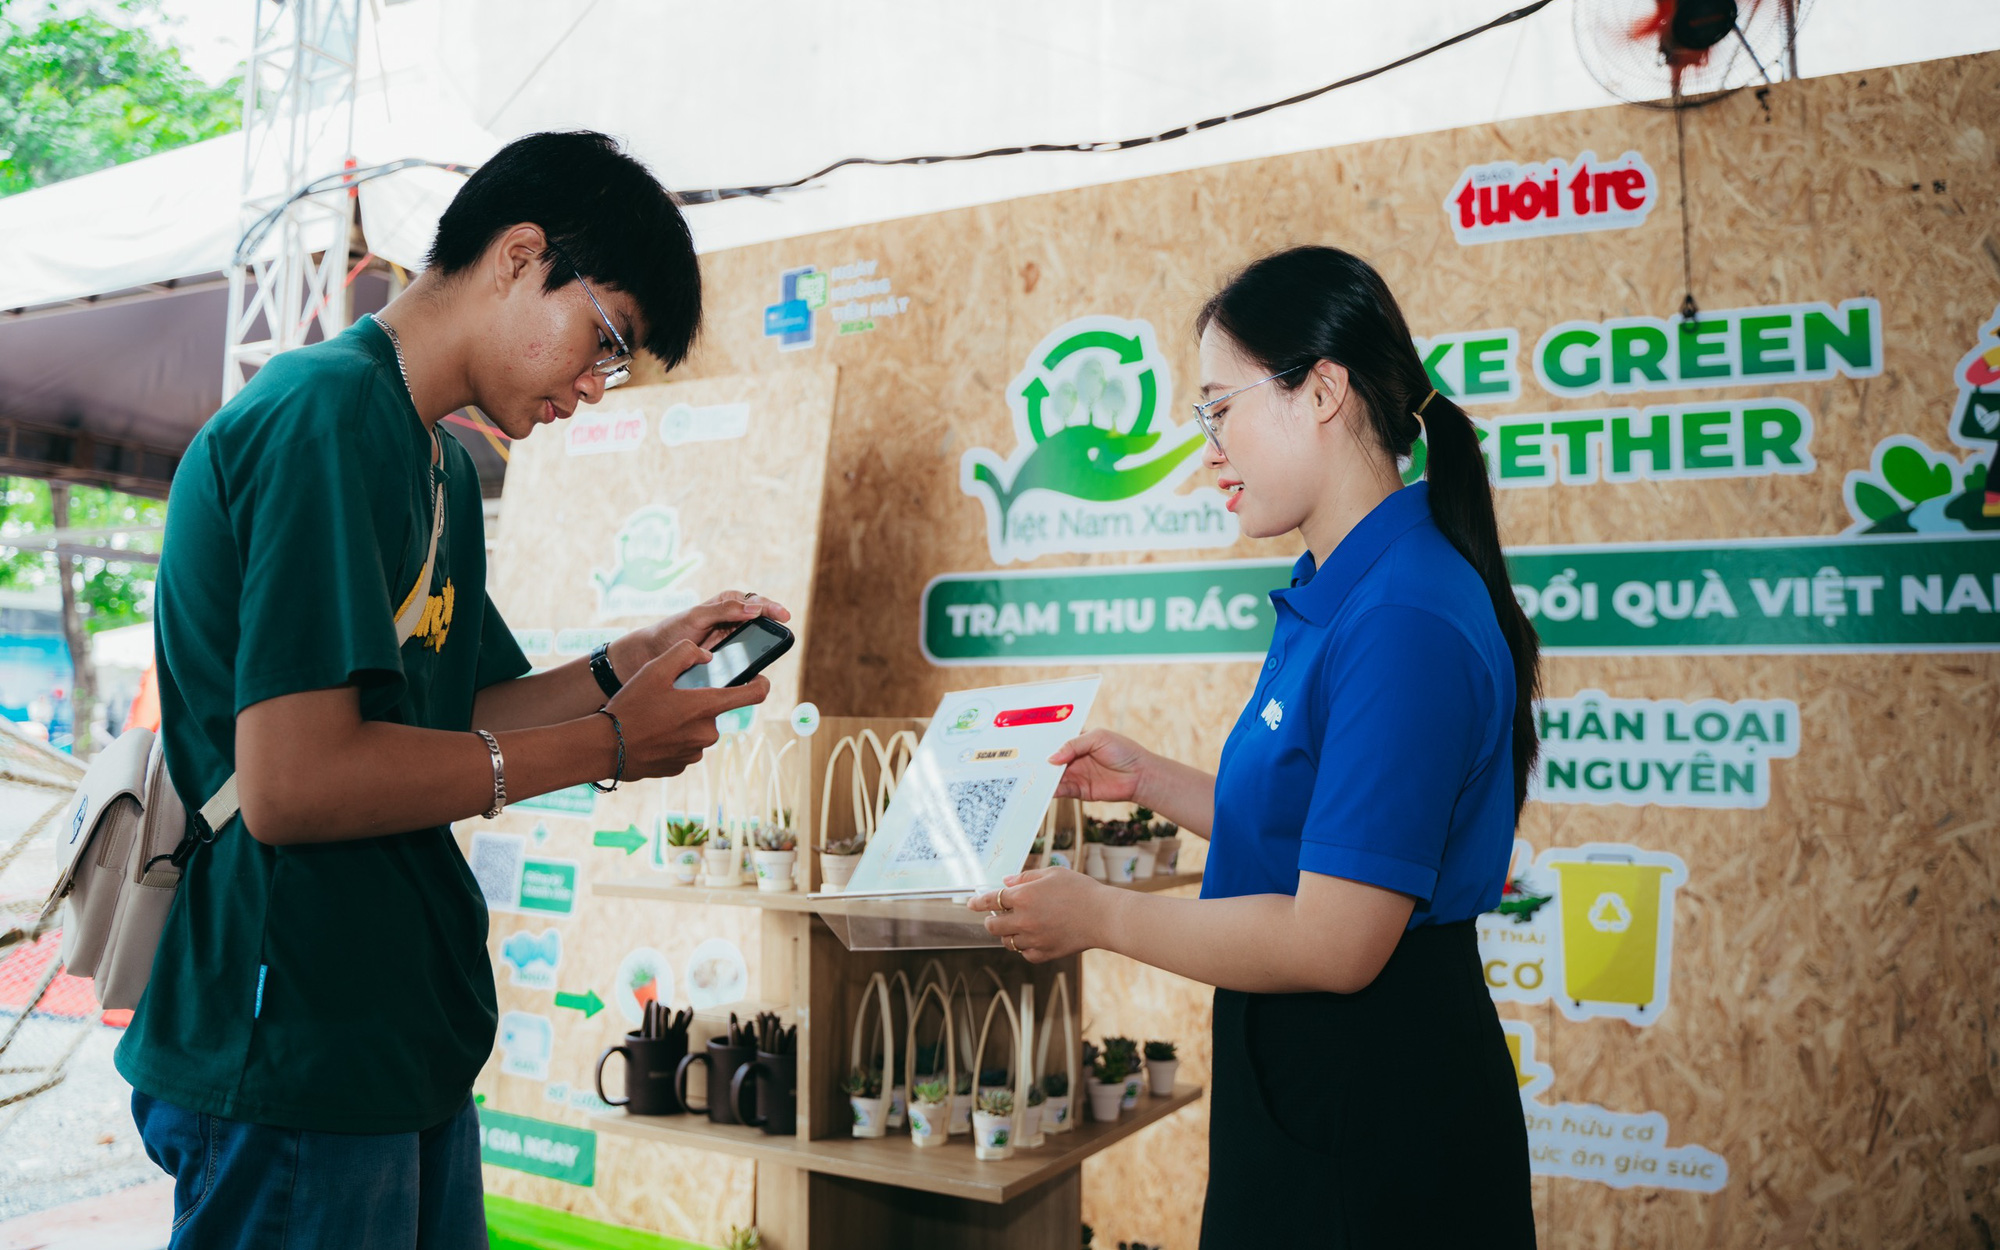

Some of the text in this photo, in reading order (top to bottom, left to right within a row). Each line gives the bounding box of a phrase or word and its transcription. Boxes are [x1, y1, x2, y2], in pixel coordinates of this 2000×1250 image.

[1414, 308, 1872, 397] KE GREEN
[1401, 408, 1803, 486] ETHER
[1058, 507, 1133, 538] Nam
[1141, 501, 1226, 535] Xanh
[945, 601, 1061, 645] TRẠM
[1068, 597, 1156, 634] THU
[1165, 585, 1259, 632] RÁC
[1612, 568, 1739, 628] QUÀ
[1750, 566, 1884, 627] VIỆT
[1901, 573, 2000, 615] NA
[1541, 701, 1786, 754] HÂN LOẠI
[975, 750, 997, 760] SCAN
[1547, 751, 1755, 794] NGUYÊN
[1484, 957, 1545, 991] CƠ
[1614, 1151, 1658, 1175] gia
[1666, 1156, 1716, 1180] súc
